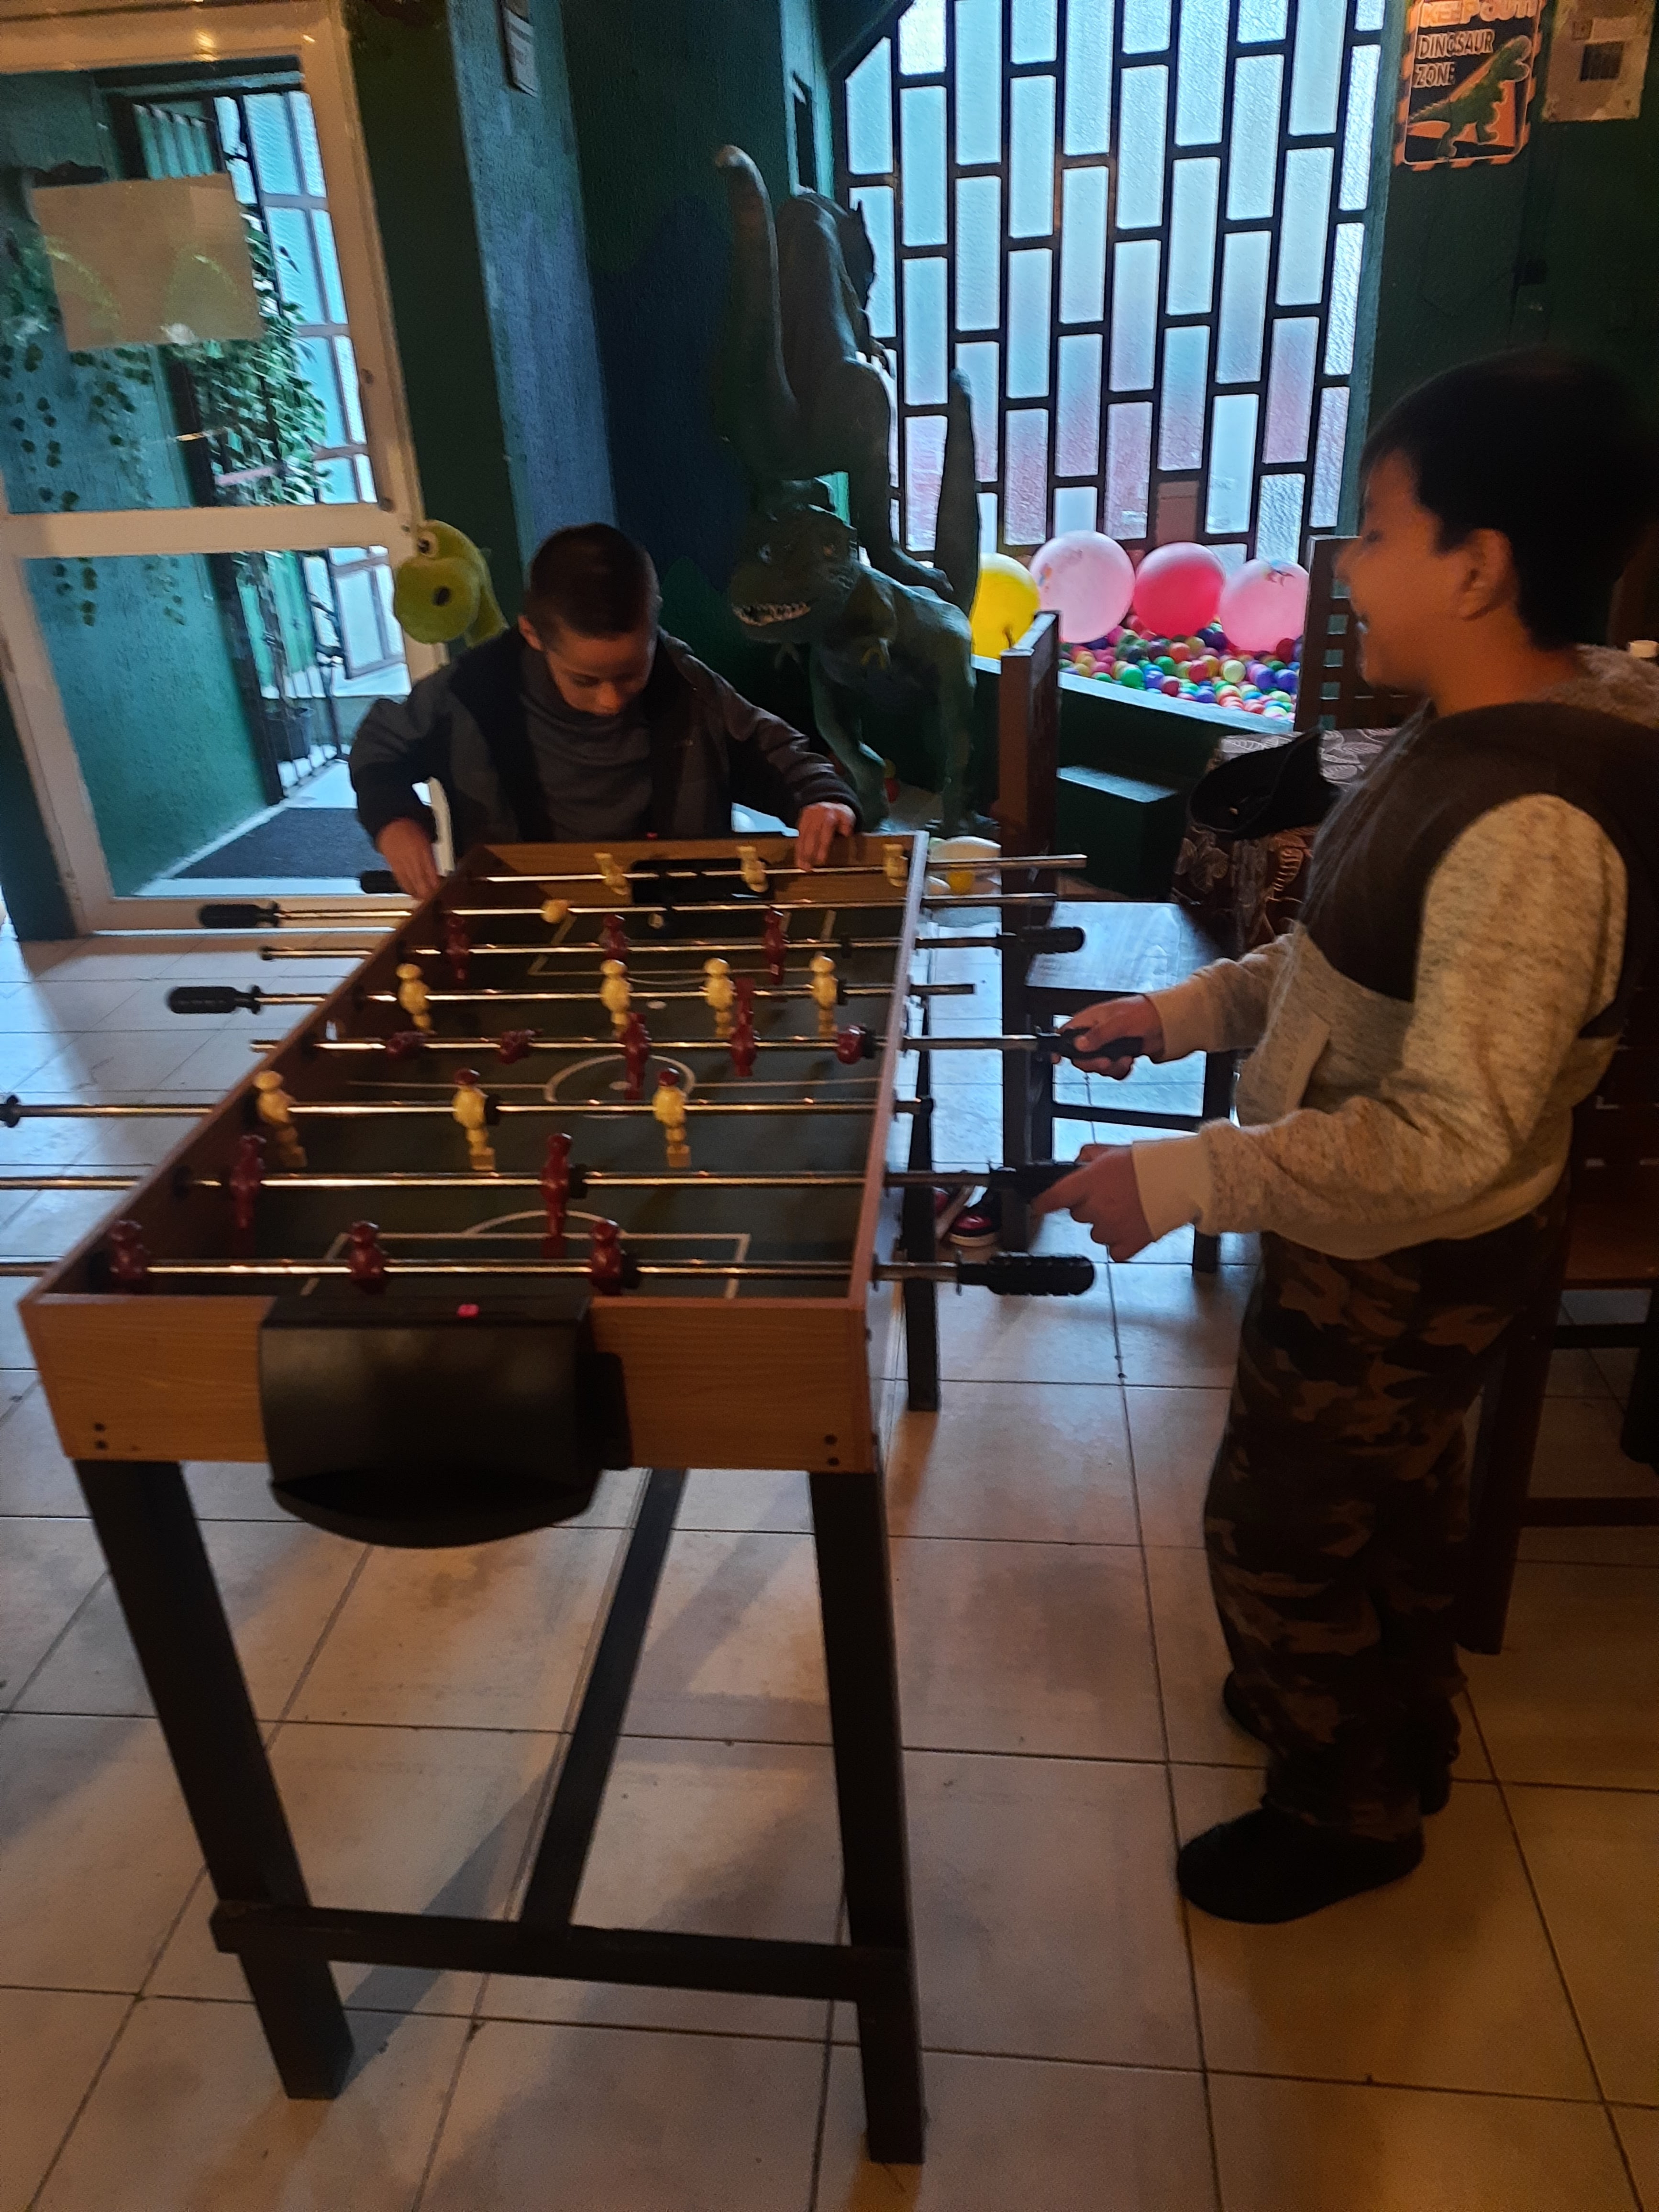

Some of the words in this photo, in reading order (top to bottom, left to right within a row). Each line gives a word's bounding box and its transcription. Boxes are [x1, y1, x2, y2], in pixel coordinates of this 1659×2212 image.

[1421, 0, 1480, 27] KEEP
[1418, 29, 1494, 58] DINOSAUR
[1414, 62, 1455, 88] ZONE
